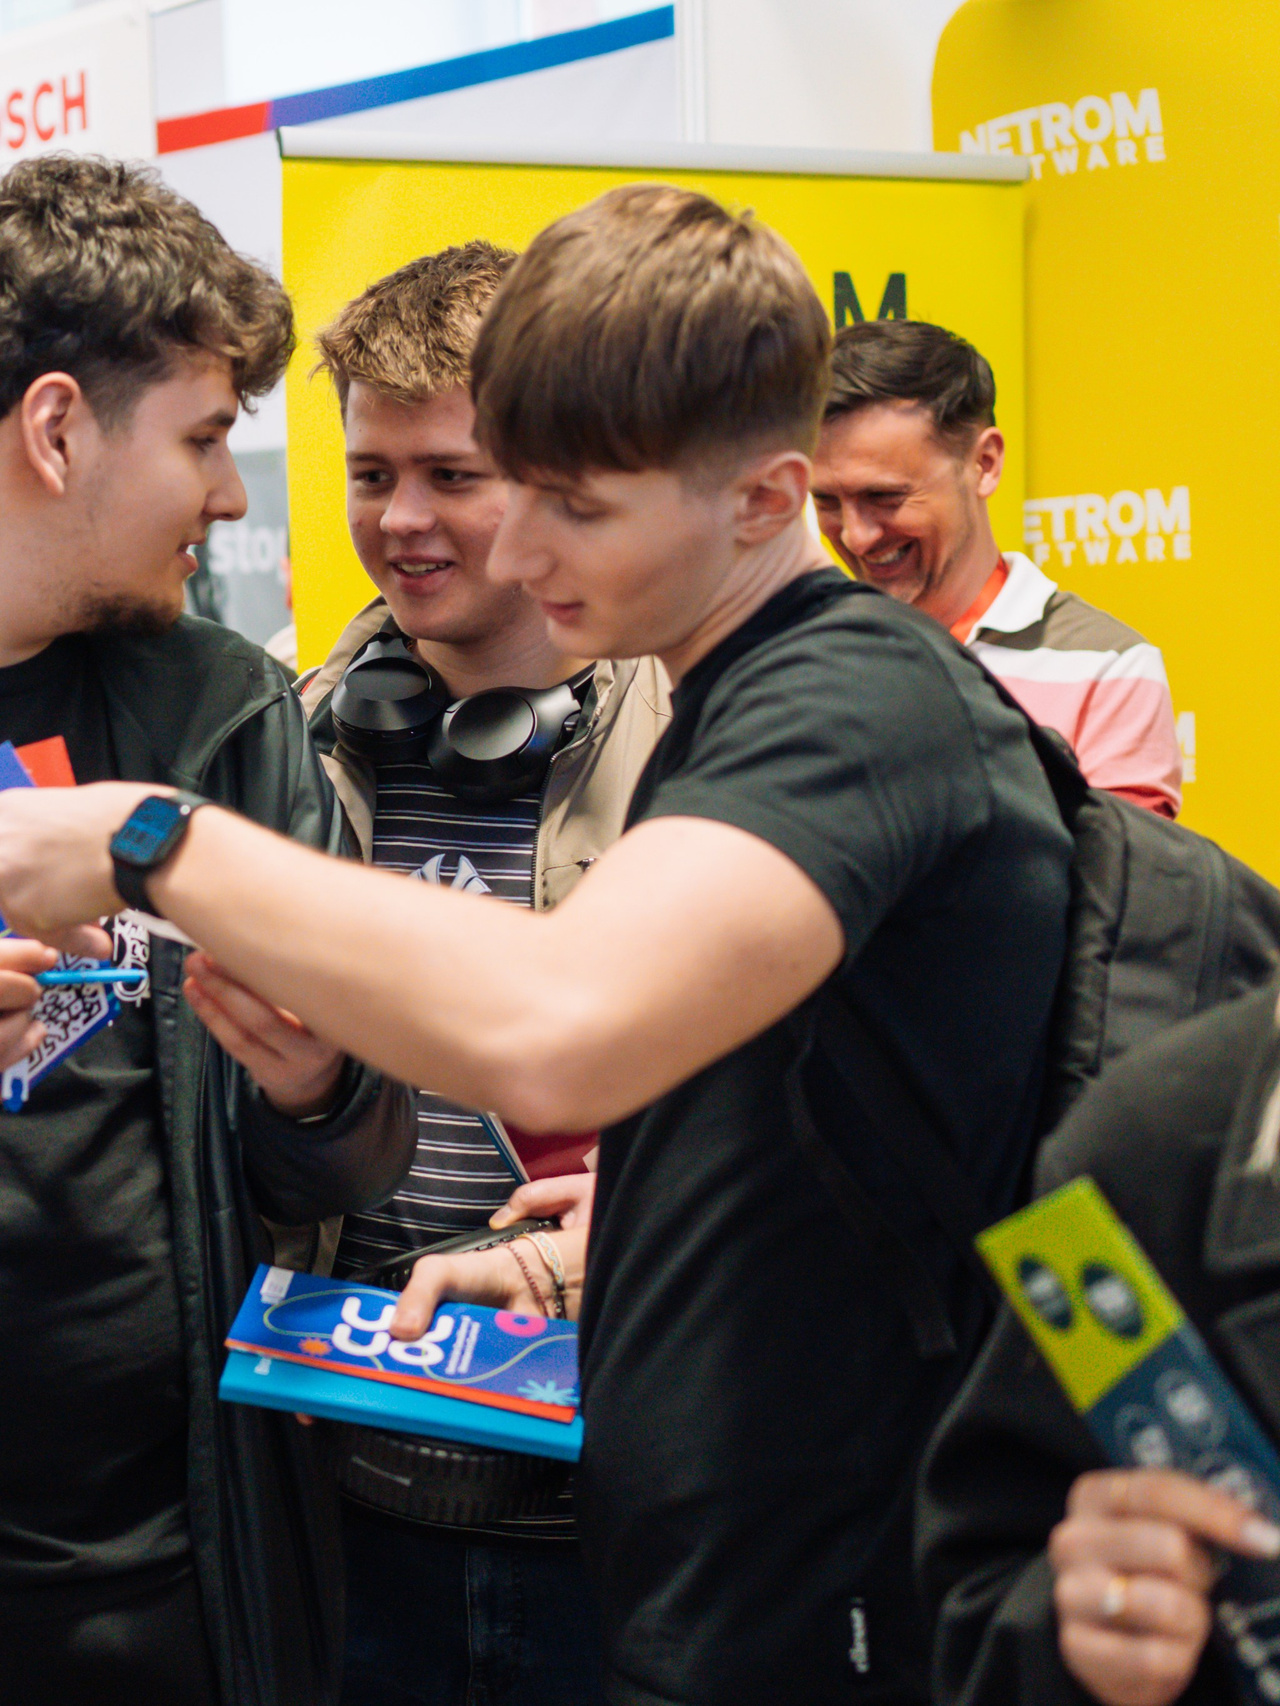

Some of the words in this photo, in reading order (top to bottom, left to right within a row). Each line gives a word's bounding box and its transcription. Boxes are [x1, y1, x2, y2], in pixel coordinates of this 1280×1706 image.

[958, 87, 1163, 156] NETROM
[1030, 134, 1166, 180] TWARE
[1023, 485, 1191, 545] ETROM
[1033, 532, 1192, 568] FTWARE
